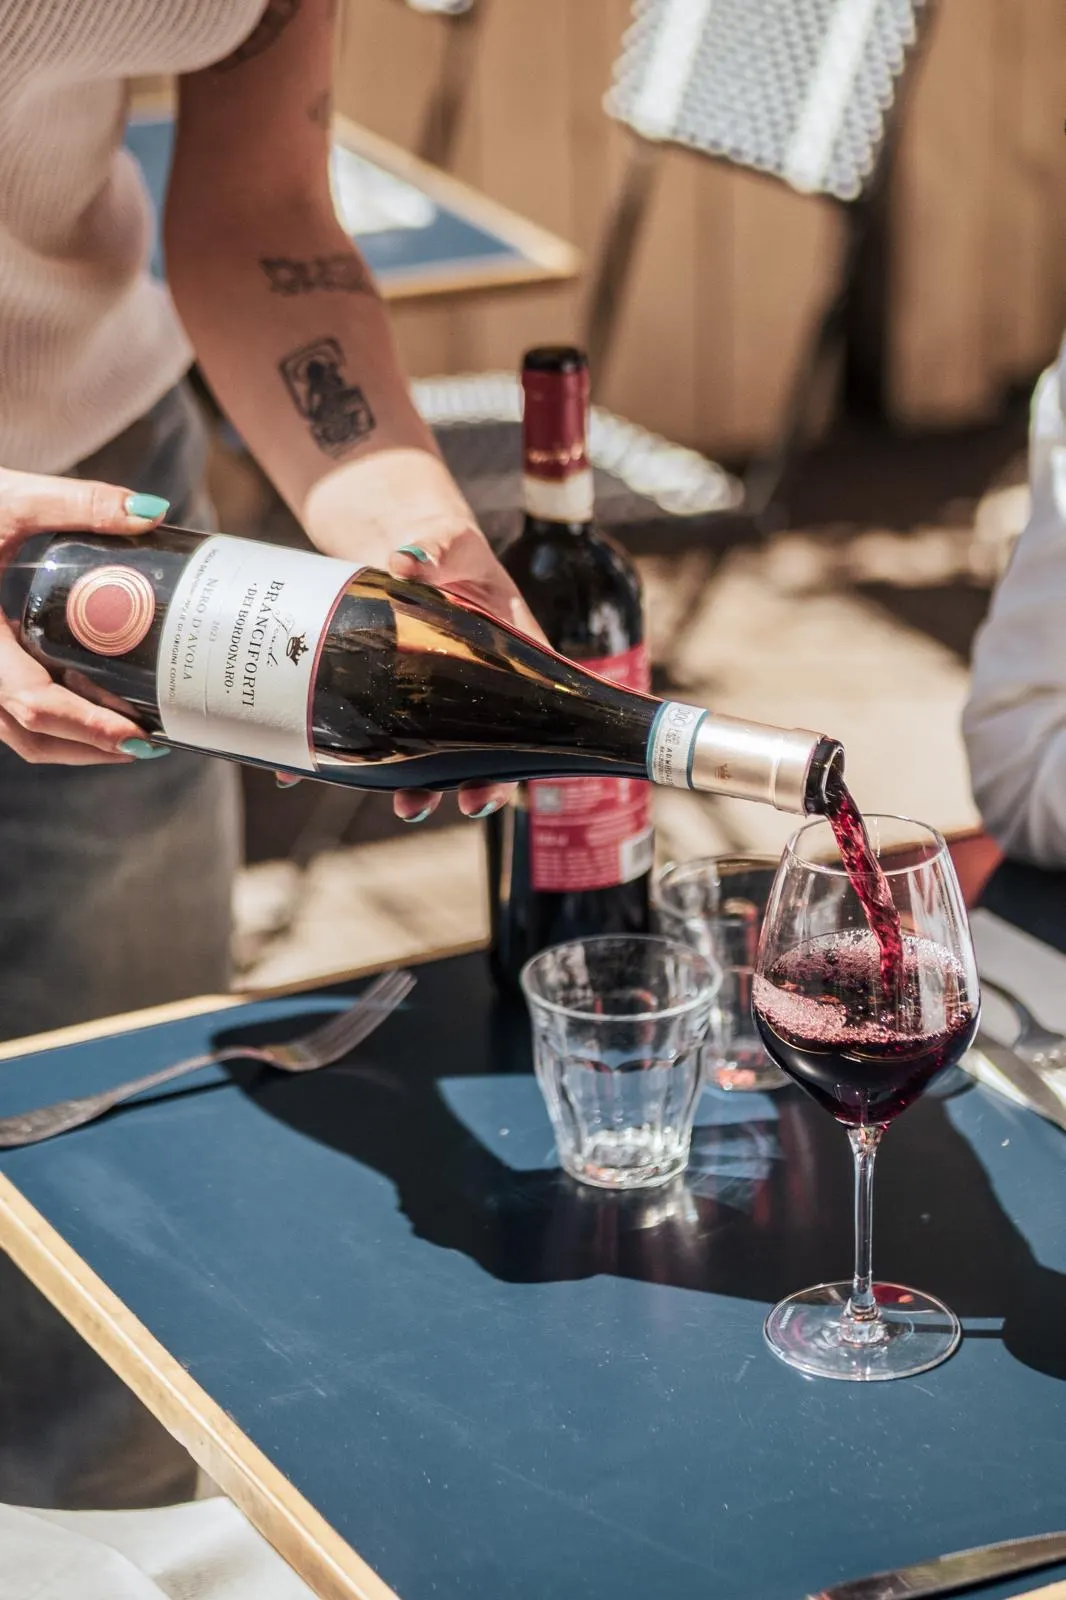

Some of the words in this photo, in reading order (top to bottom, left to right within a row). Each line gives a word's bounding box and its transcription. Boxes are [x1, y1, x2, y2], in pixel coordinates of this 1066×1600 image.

[196, 577, 219, 614] NERO
[242, 588, 258, 608] DEI
[170, 633, 182, 666] ORIGINE
[183, 617, 202, 681] D'AVOLA
[208, 620, 220, 643] 2023
[224, 610, 249, 688] BORDONARO
[242, 580, 286, 707] BRANCIFORTI
